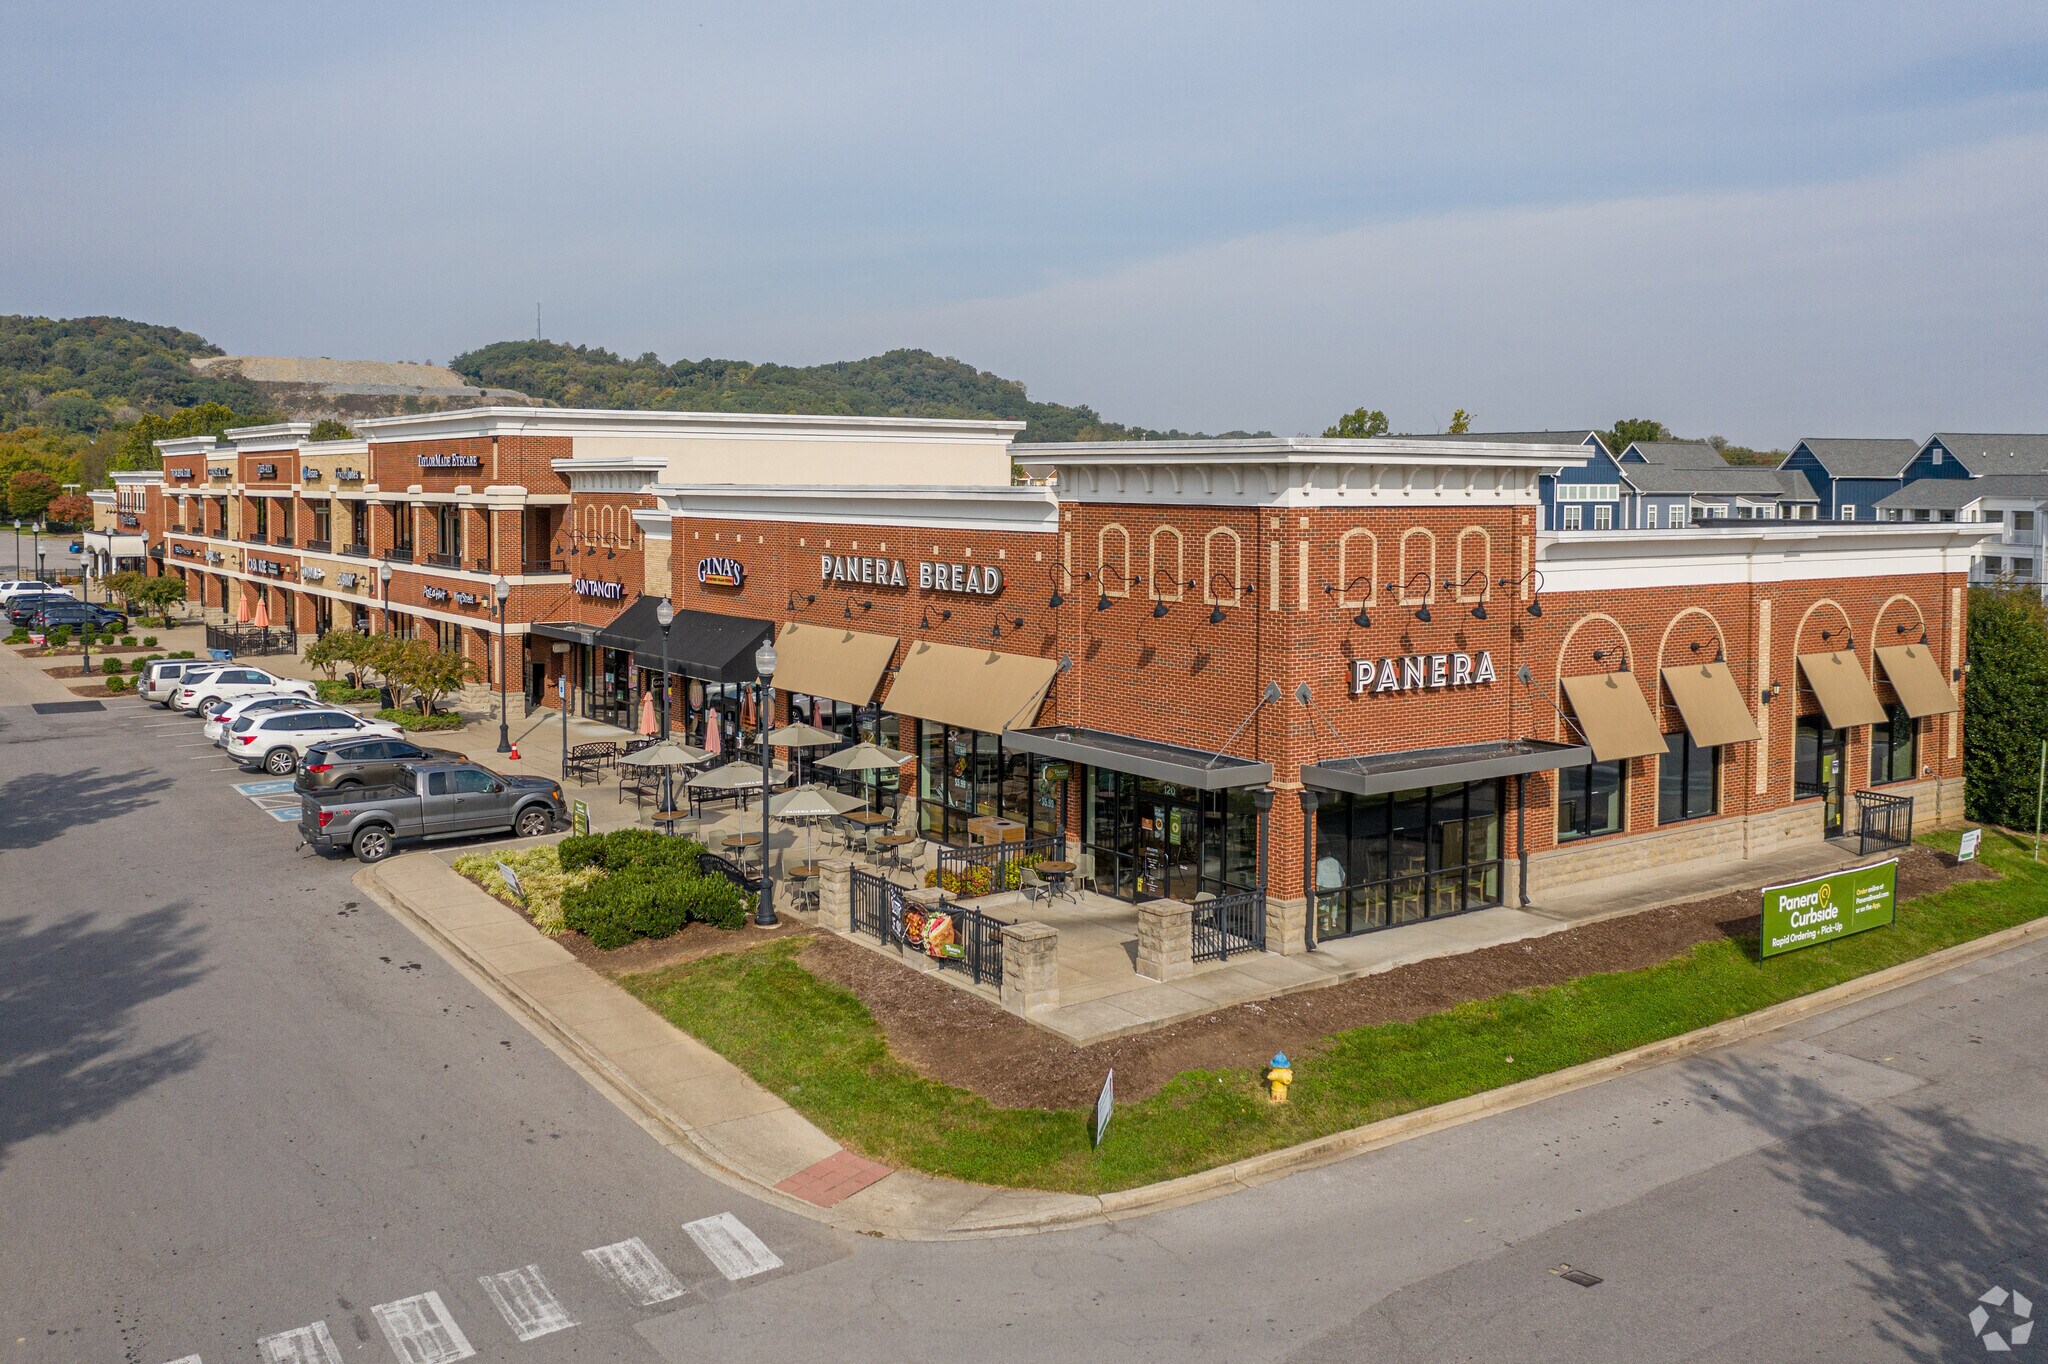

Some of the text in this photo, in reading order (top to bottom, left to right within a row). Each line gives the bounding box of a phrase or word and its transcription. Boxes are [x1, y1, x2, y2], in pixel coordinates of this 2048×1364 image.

[451, 453, 478, 467] EYECARE
[697, 557, 741, 586] GINA'S
[821, 554, 1005, 595] PANERA BREAD
[575, 578, 621, 600] SUN TAN CITY
[1352, 651, 1497, 694] PANERA
[1163, 785, 1176, 796] 120
[1778, 893, 1819, 913] Panera
[1790, 903, 1839, 928] Curbside
[1771, 934, 1790, 948] Rapid
[1789, 930, 1817, 942] Ordering
[1820, 922, 1843, 935] Pick-Up
